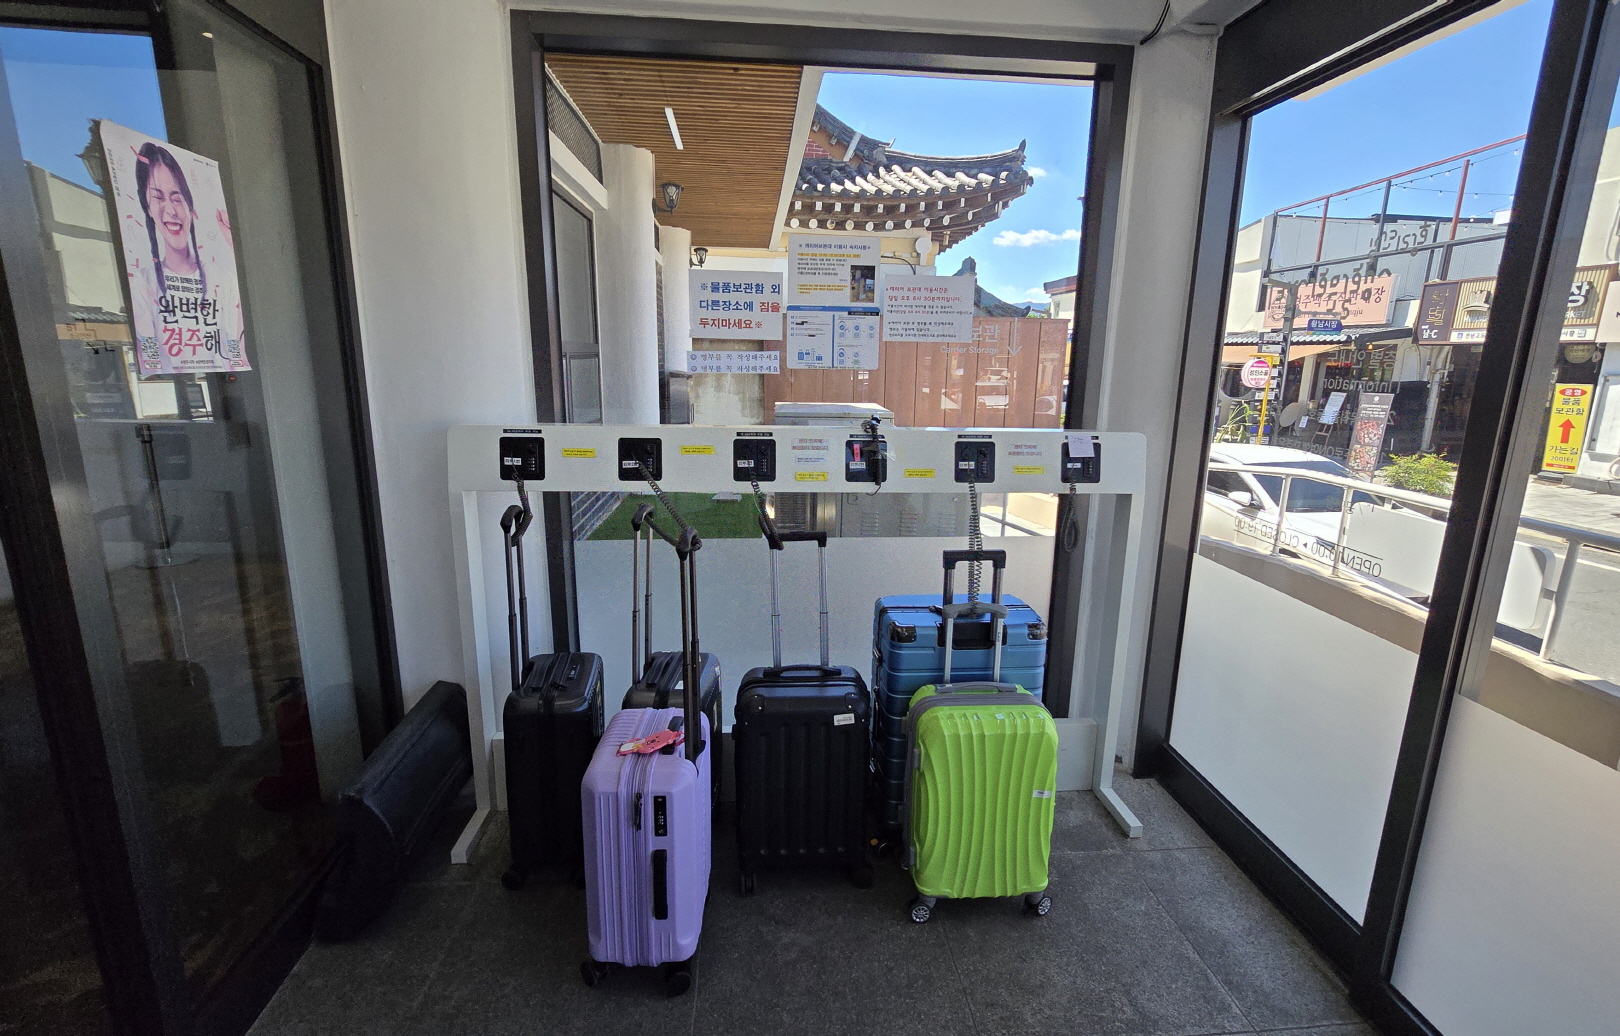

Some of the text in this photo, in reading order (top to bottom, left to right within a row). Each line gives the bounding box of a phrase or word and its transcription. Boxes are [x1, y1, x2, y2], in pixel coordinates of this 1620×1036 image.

[770, 283, 780, 295] 외
[158, 293, 220, 327] 완벽한
[699, 299, 781, 313] 다른장소에 짐을
[1310, 319, 1338, 328] 황남시장
[162, 326, 224, 358] 경주해
[940, 346, 999, 355] Carrier Storage
[1561, 397, 1582, 406] 물품
[1554, 407, 1585, 416] 보관함
[1550, 456, 1574, 464] 20미터
